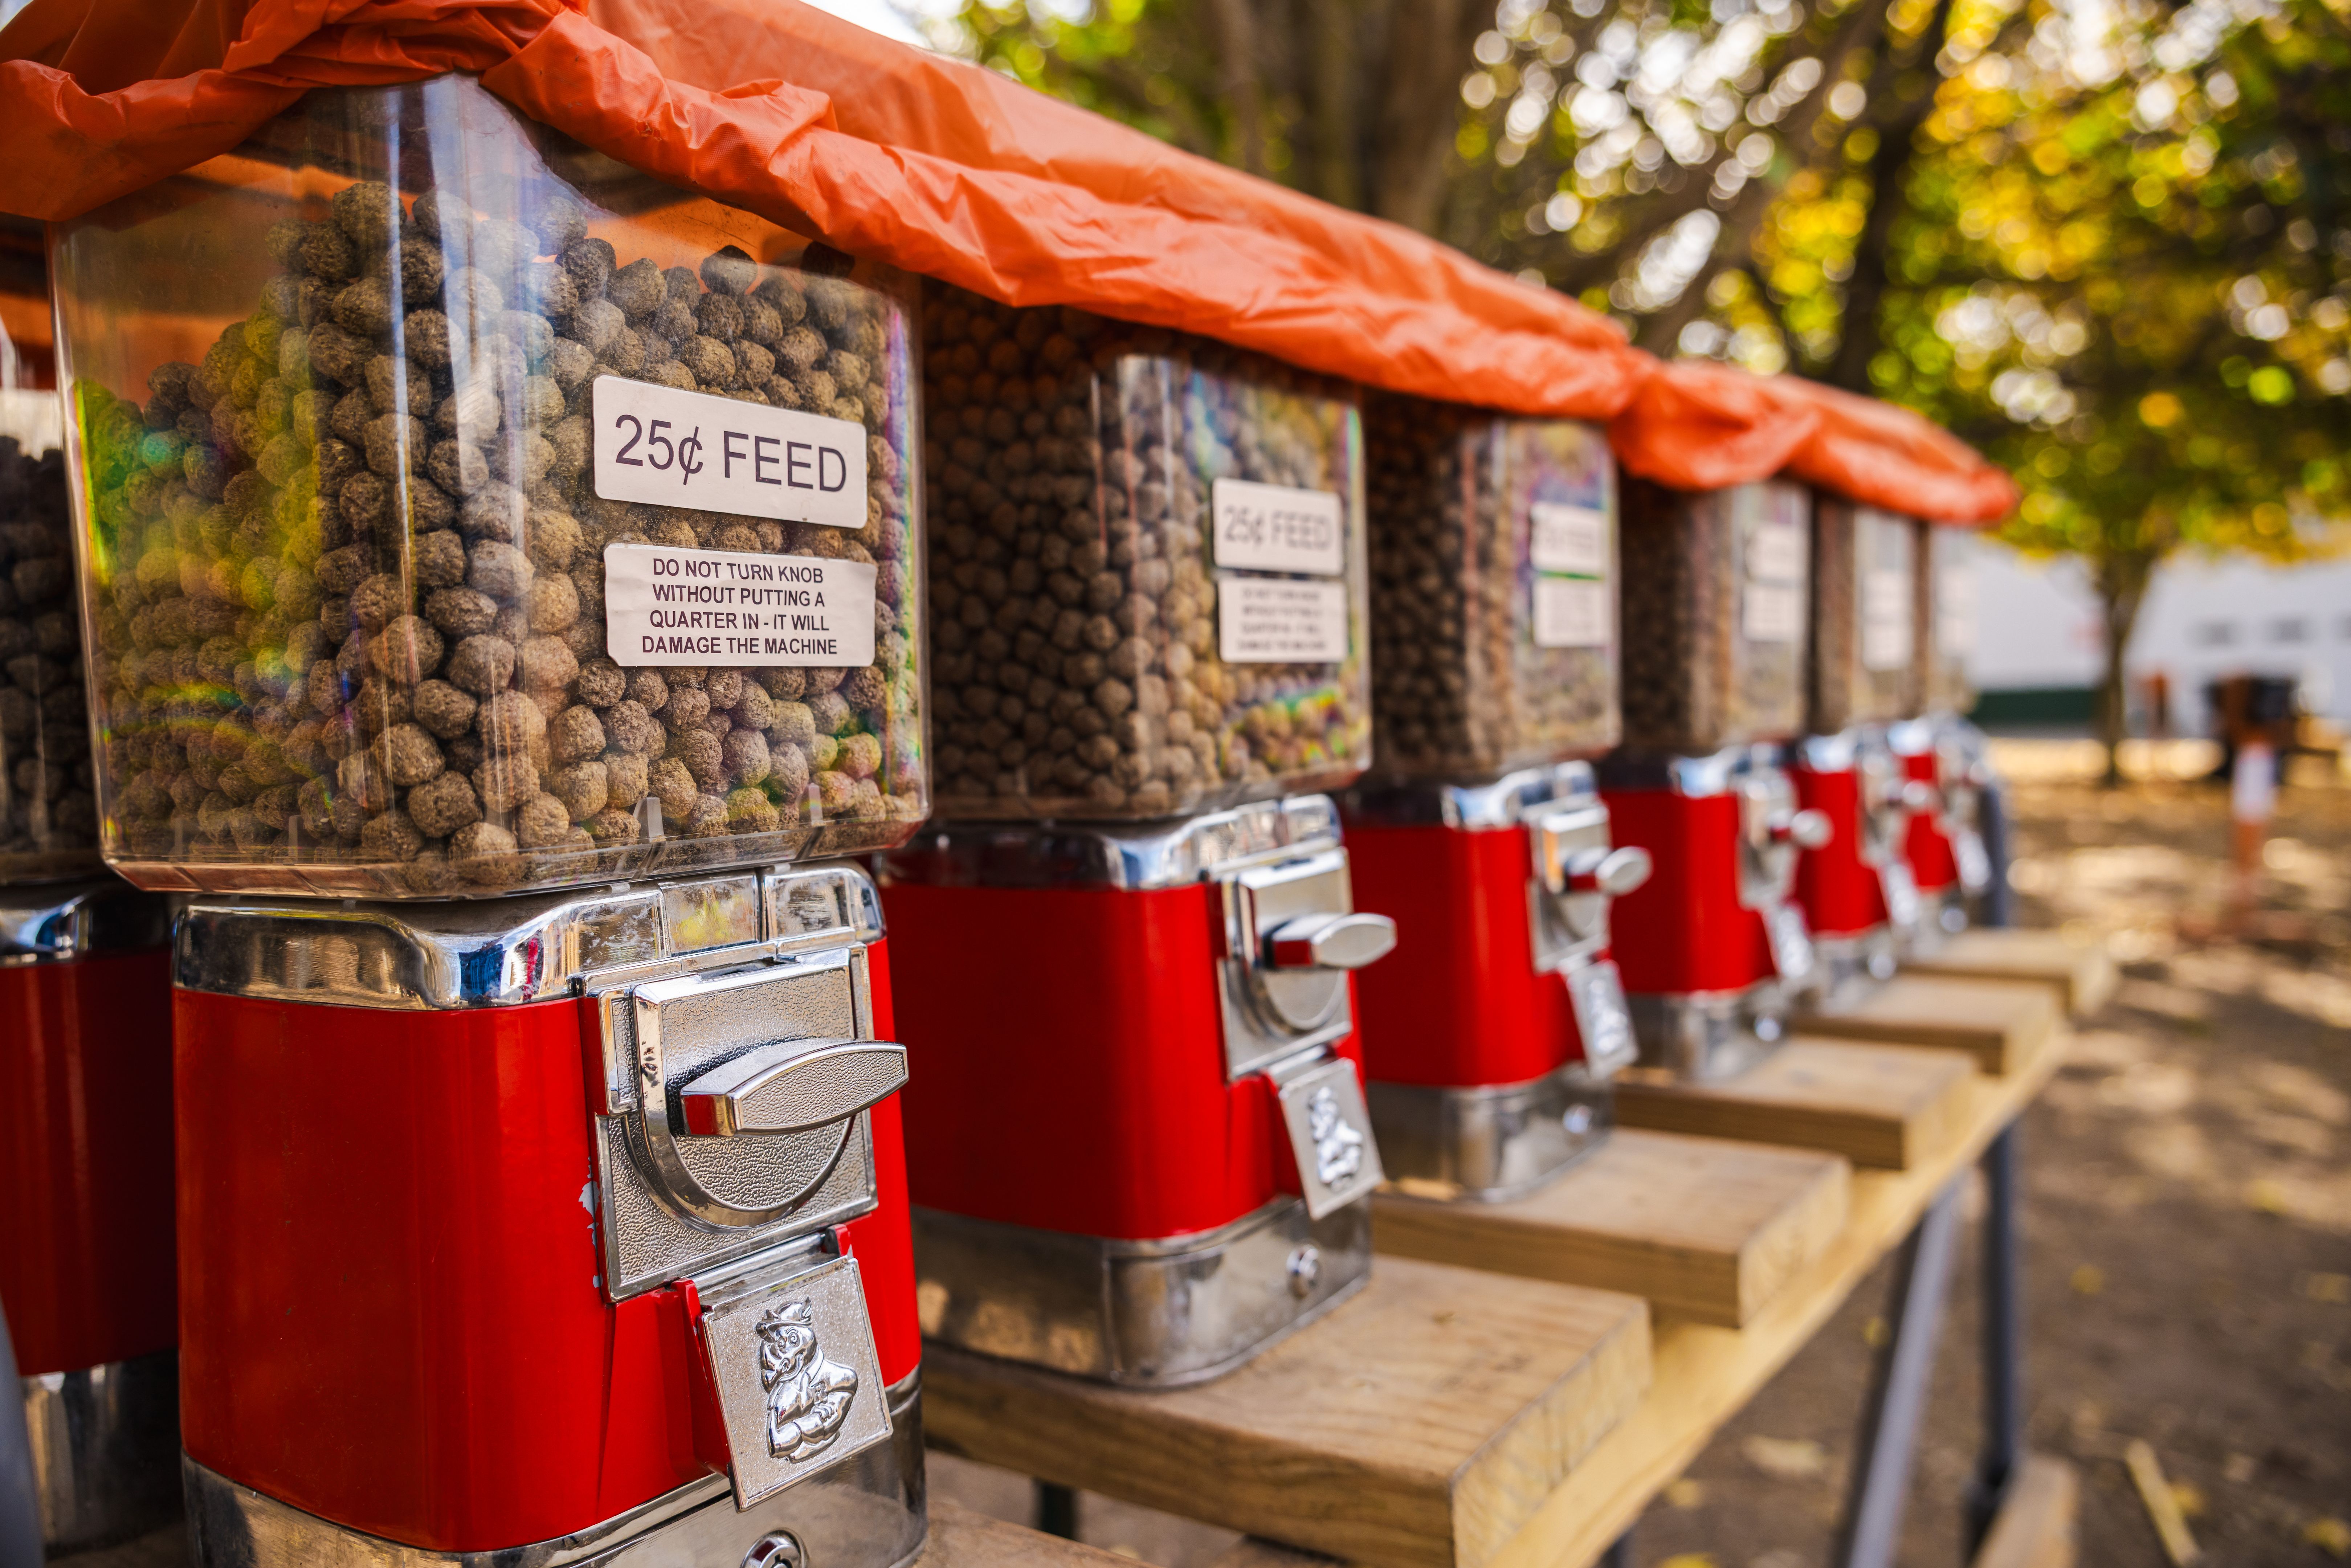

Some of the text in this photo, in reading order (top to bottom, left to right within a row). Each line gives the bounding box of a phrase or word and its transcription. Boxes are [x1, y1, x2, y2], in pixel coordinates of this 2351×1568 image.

[616, 415, 846, 493] 25¢ FEED
[653, 559, 823, 583] DO NOT TURN KNOB
[653, 584, 825, 607] WITHOUT PUTTING A
[650, 610, 738, 629] QUARTER
[743, 613, 759, 629] IN
[774, 614, 786, 630] IT
[791, 615, 829, 631] WILL
[643, 636, 837, 654] DAMAGE THE MACHINE
